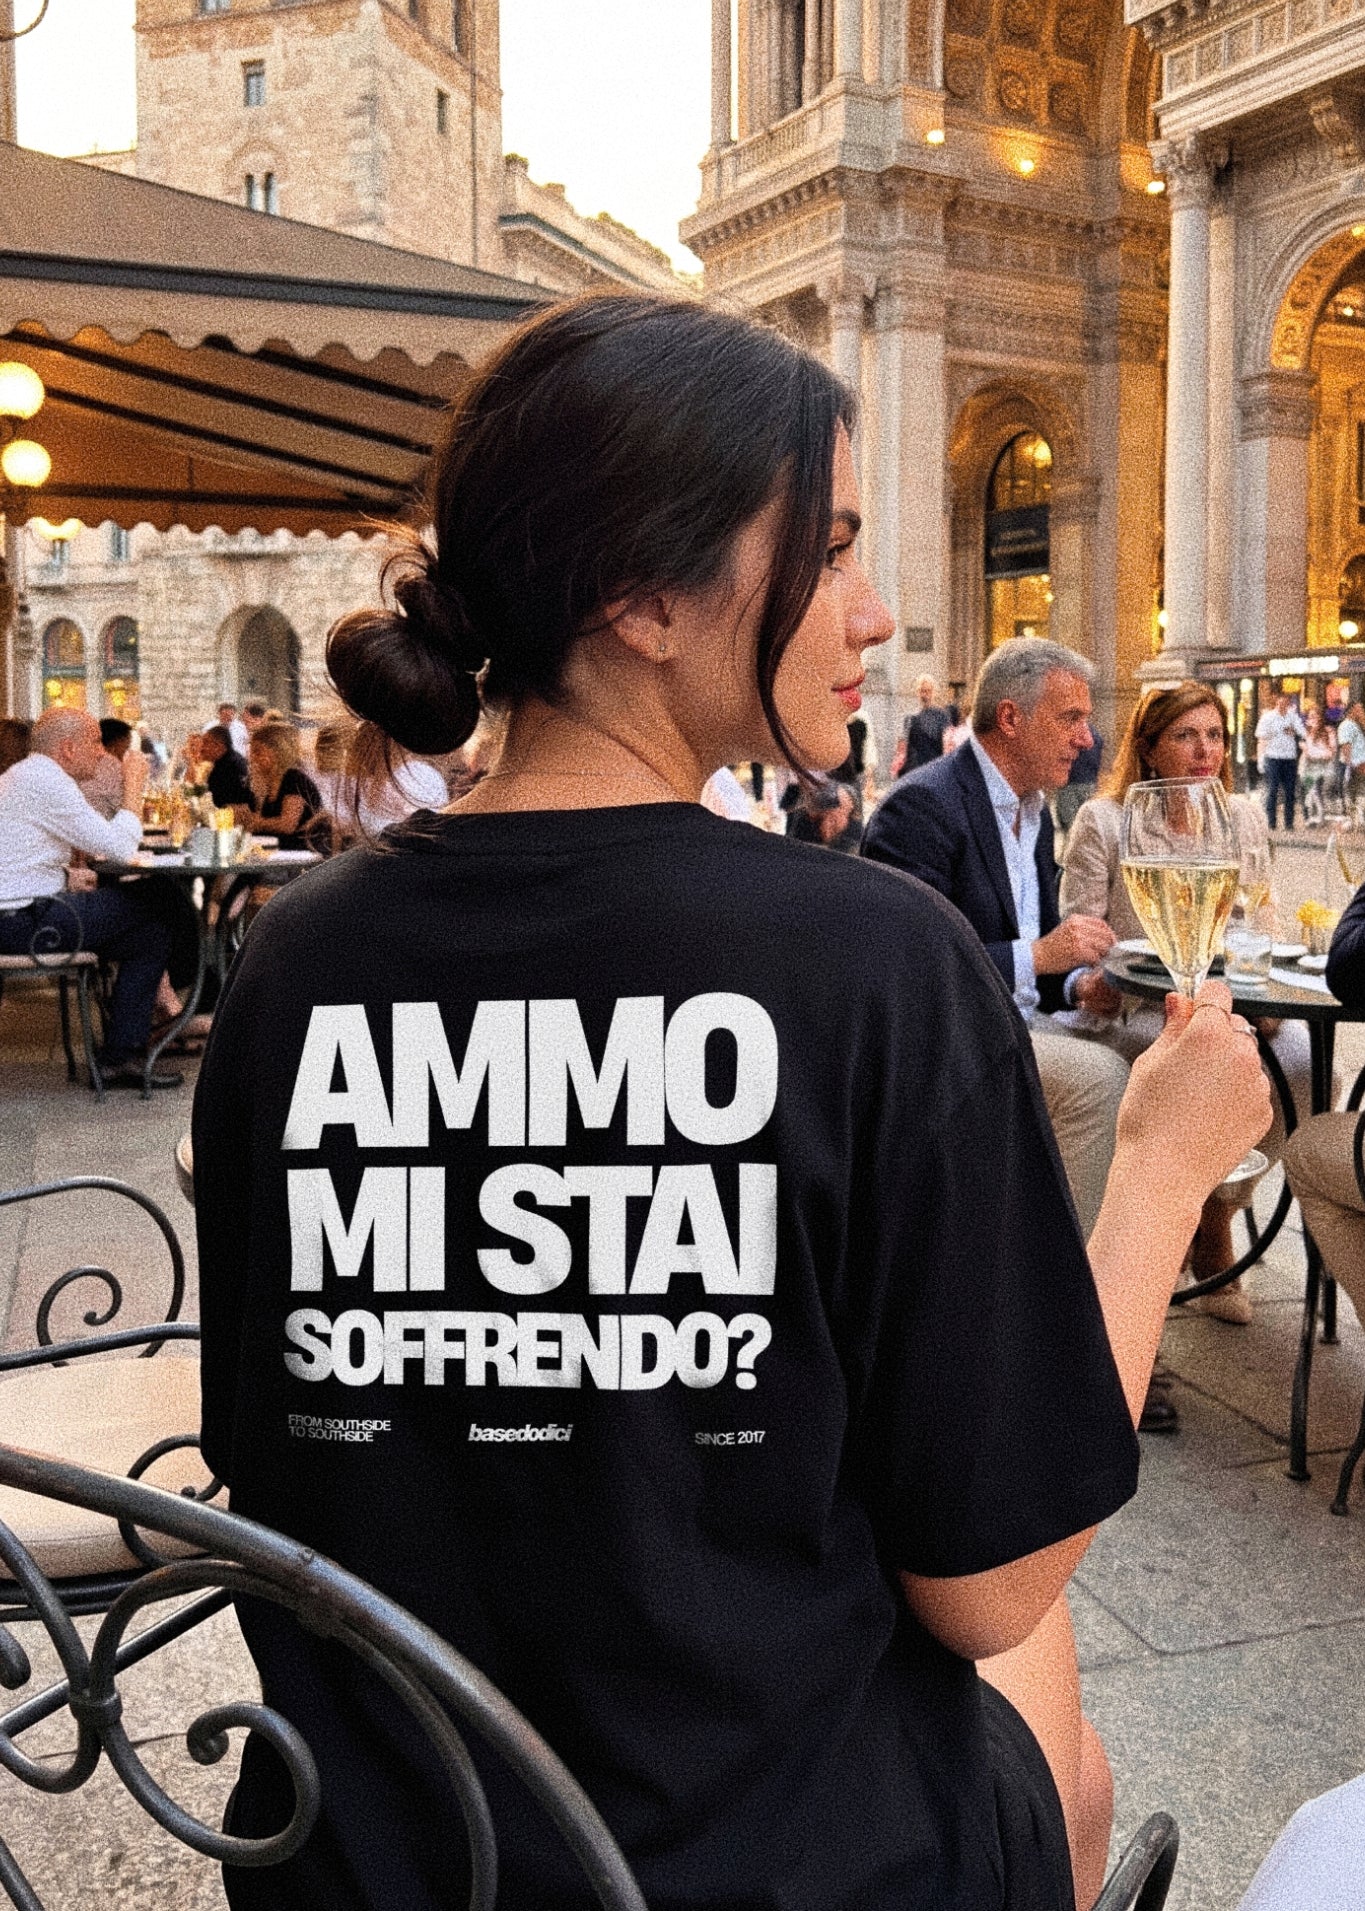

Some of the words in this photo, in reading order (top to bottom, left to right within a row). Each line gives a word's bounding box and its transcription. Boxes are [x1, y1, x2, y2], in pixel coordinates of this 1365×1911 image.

[281, 992, 779, 1149] AMMO
[287, 1165, 446, 1292] MI
[477, 1163, 778, 1296] STAI
[283, 1308, 773, 1391] SOFFRENDO?
[288, 1414, 322, 1428] FROM
[324, 1418, 391, 1431] SOUTHSIDE
[289, 1426, 306, 1437] TO
[308, 1427, 374, 1442] SOUTHSIDE
[468, 1423, 573, 1442] basedodici
[695, 1432, 735, 1446] SINCE
[737, 1430, 766, 1444] 2017
